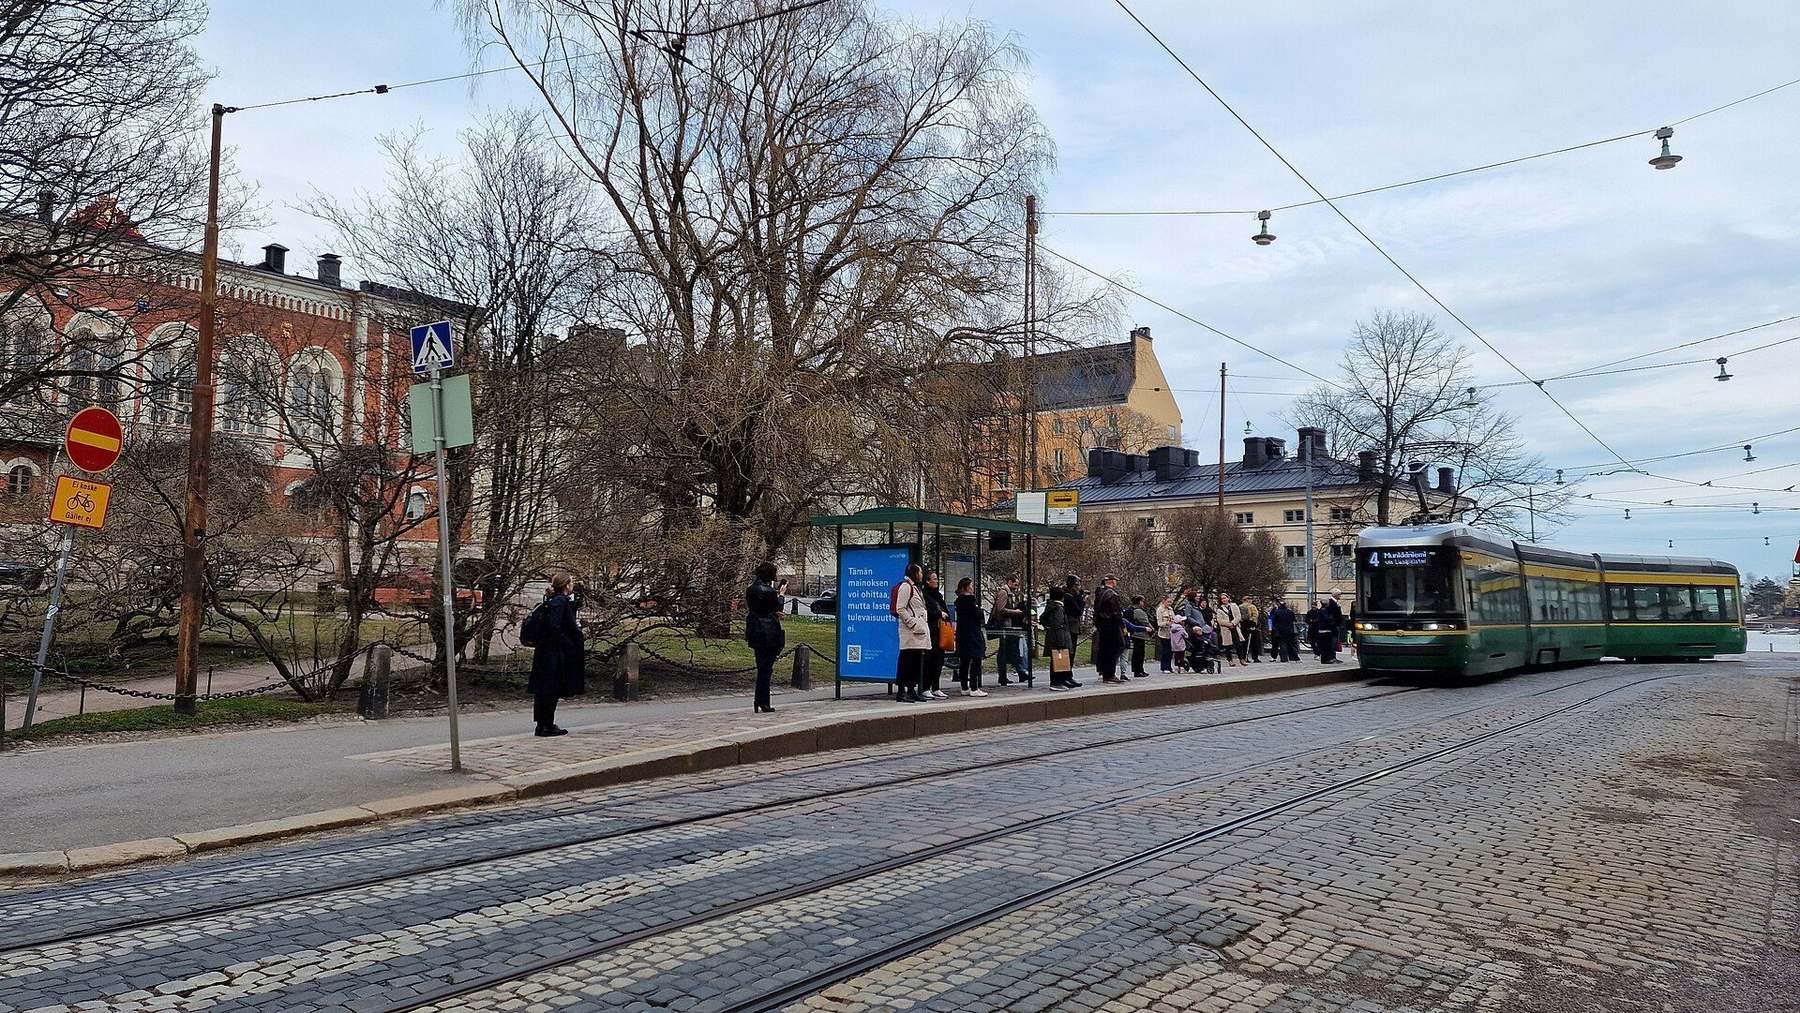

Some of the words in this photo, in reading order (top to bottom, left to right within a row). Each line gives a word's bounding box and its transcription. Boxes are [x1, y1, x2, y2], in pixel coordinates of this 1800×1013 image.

[1369, 552, 1380, 566] 4
[848, 567, 873, 576] Tämän
[848, 579, 889, 587] mainoksen
[848, 590, 860, 598] voi
[861, 590, 890, 599] ohittaa,
[872, 602, 890, 610] laste
[847, 613, 896, 622] tulevaisuutta
[847, 624, 857, 633] ei.
